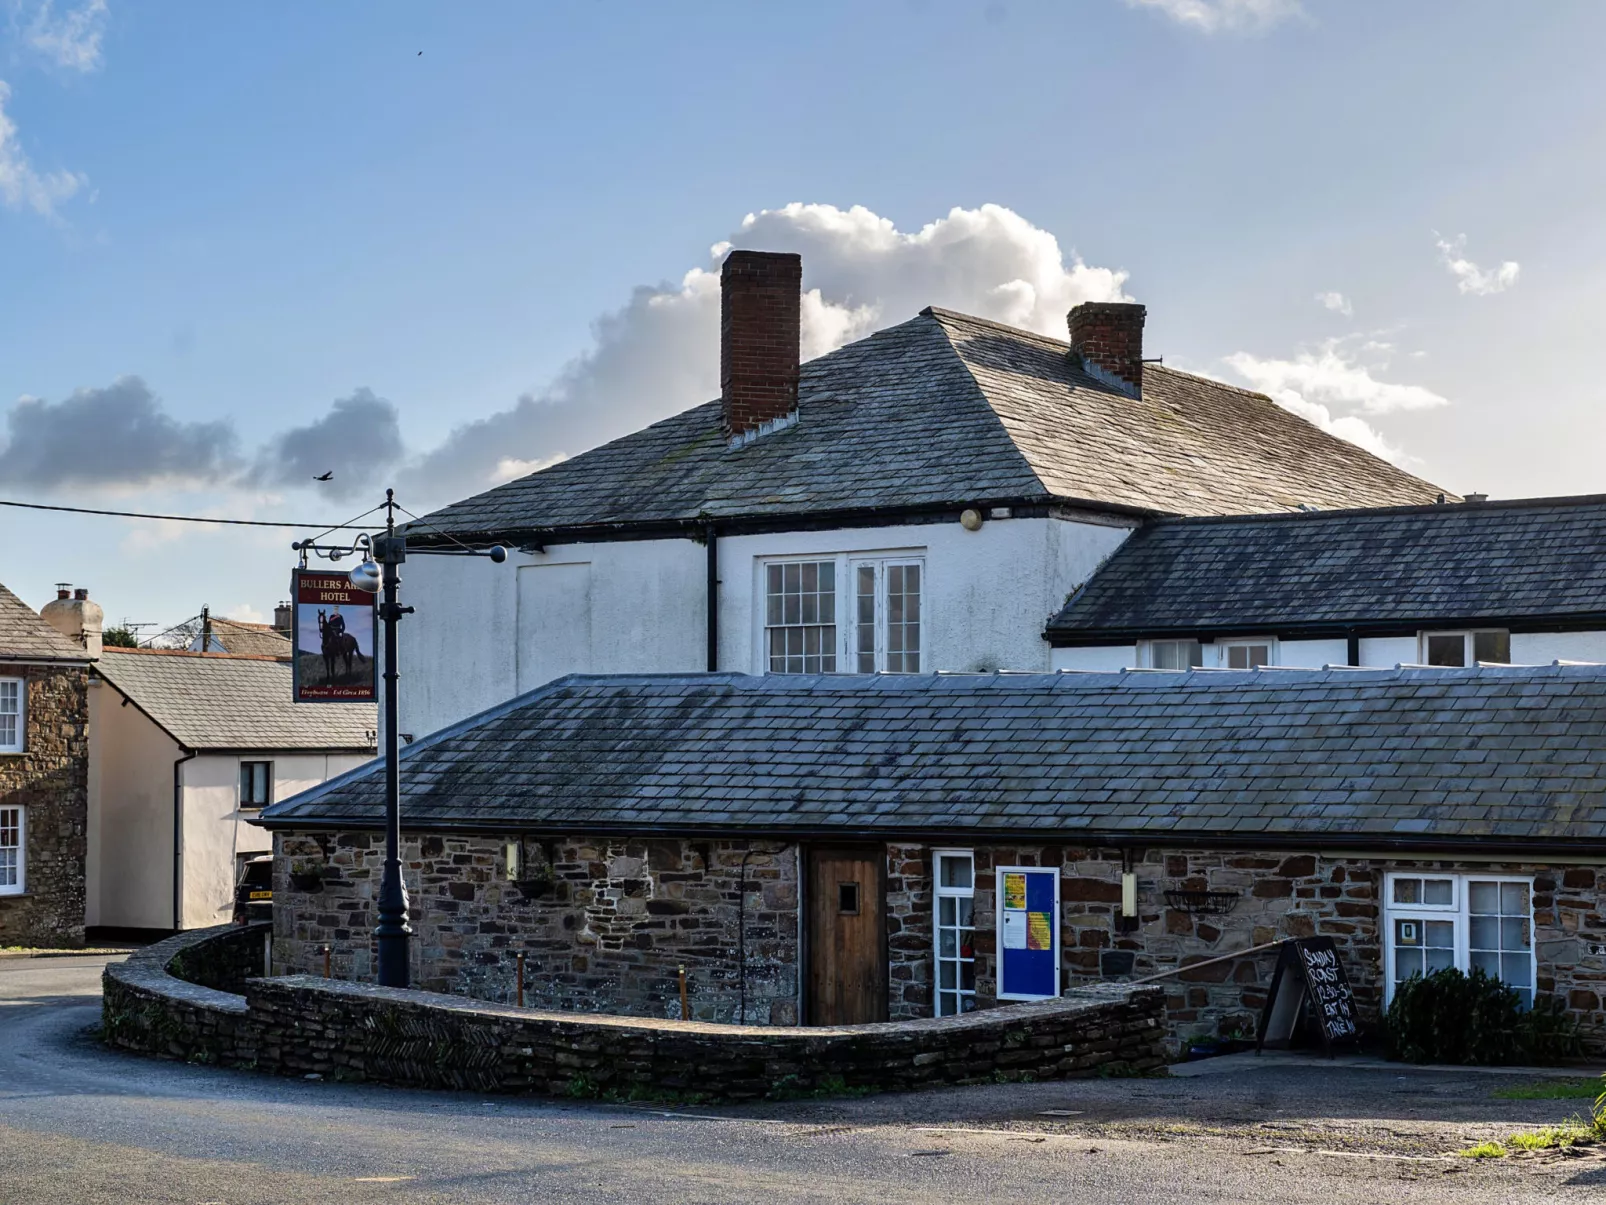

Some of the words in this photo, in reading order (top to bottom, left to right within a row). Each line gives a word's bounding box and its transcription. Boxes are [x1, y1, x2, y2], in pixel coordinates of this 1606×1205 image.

[301, 580, 341, 589] BULLERS
[320, 592, 350, 601] HOTEL
[1304, 948, 1335, 967] SUNDAY
[1308, 966, 1339, 987] ROAST
[1326, 1020, 1348, 1038] TAKE
